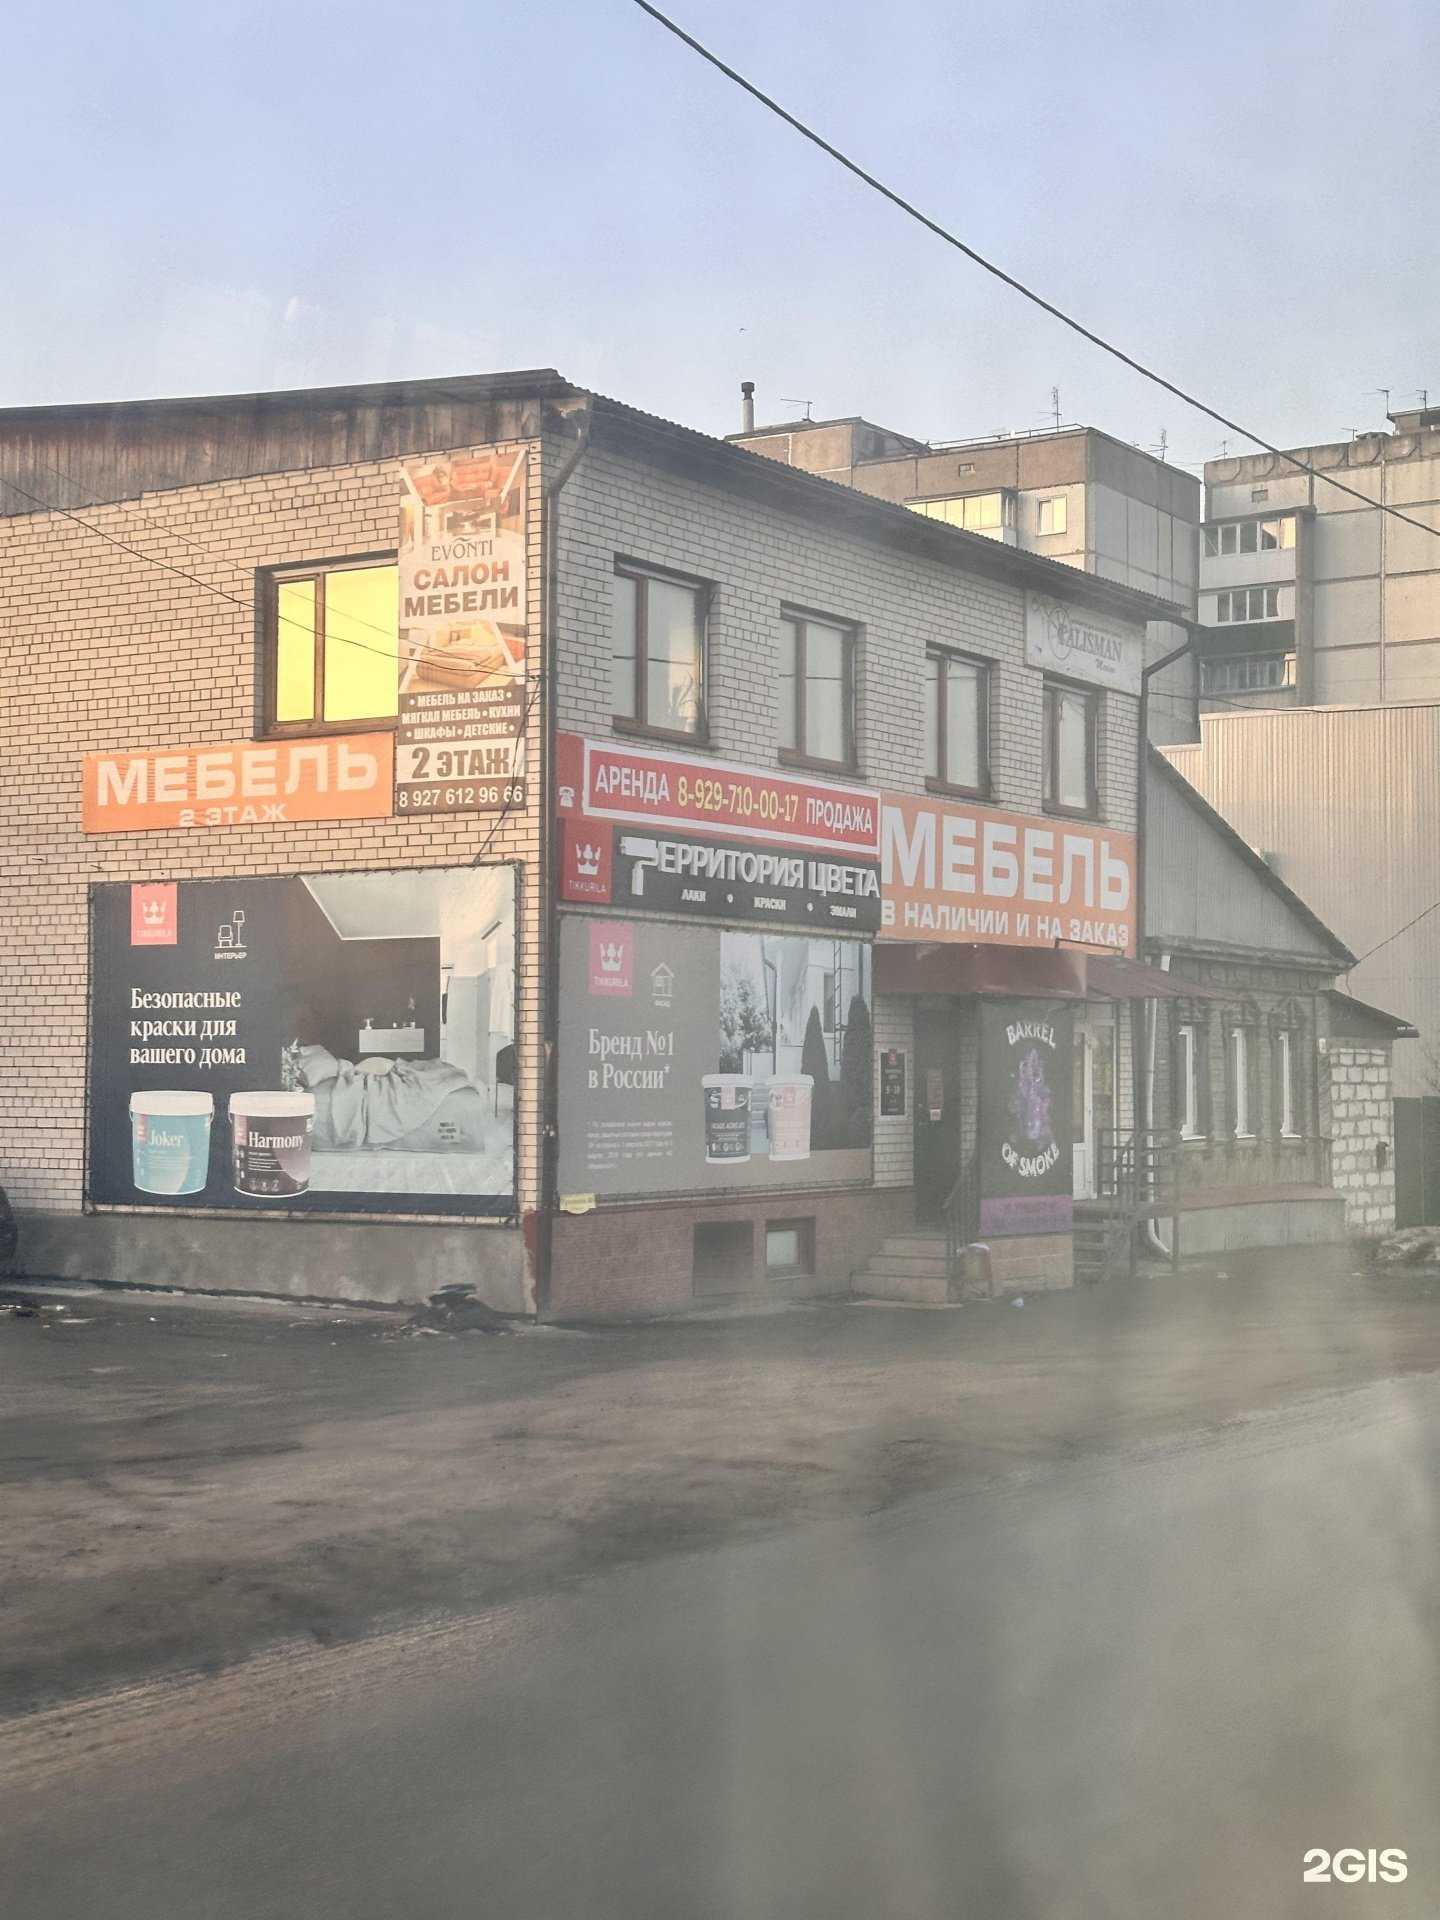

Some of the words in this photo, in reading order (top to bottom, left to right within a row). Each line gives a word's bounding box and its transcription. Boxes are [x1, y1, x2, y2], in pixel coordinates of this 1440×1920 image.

[413, 560, 510, 590] САЛОН
[404, 586, 519, 617] МЕБЕЛИ
[417, 693, 456, 707] МЕБЕЛЬ
[457, 691, 471, 704] НА
[472, 689, 505, 703] ЗАКАЗ
[401, 710, 441, 724] МЯГКАЯ
[441, 707, 481, 721] МЕБЕЛЬ
[488, 704, 521, 718] КУХНИ
[413, 725, 456, 740] ШКАФЫ
[463, 722, 508, 738] ДЕТСКИЕ
[96, 743, 378, 806] МЕБЕЛЬ
[411, 747, 430, 779] 2
[436, 747, 510, 777] ЭТАЖ
[399, 791, 408, 807] 8
[412, 789, 441, 807] 927
[445, 787, 475, 805] 612
[479, 786, 498, 803] 96
[503, 785, 523, 802] 66
[595, 764, 671, 805] АРЕНДА
[677, 775, 799, 823] 8-929-710-00-17
[805, 798, 873, 834] ПРОДАЖА
[178, 808, 197, 827] 2
[204, 803, 289, 827] ЭТАЖ
[881, 805, 1130, 911] МЕБЕЛЬ
[807, 861, 881, 898] ЦВЕТА
[681, 889, 706, 902] ЛАКИ
[753, 896, 786, 911] КРАСКИ
[829, 905, 857, 918] ЭМАЛИ
[881, 900, 896, 926] В
[904, 902, 1009, 936] НАЛИЧИИ
[1016, 913, 1029, 937] И
[1037, 916, 1063, 940] НА
[1069, 918, 1129, 946] ЗАКАЗ
[130, 988, 242, 1009] Безопасные
[130, 1020, 197, 1041] краски
[199, 1020, 237, 1041] для
[588, 1028, 642, 1061] Бренд
[645, 1030, 674, 1056] №1
[129, 1048, 196, 1064] вашего
[199, 1047, 247, 1070] дома
[588, 1069, 599, 1088] в
[149, 1130, 184, 1147] Joker
[248, 1131, 304, 1149] Harmony
